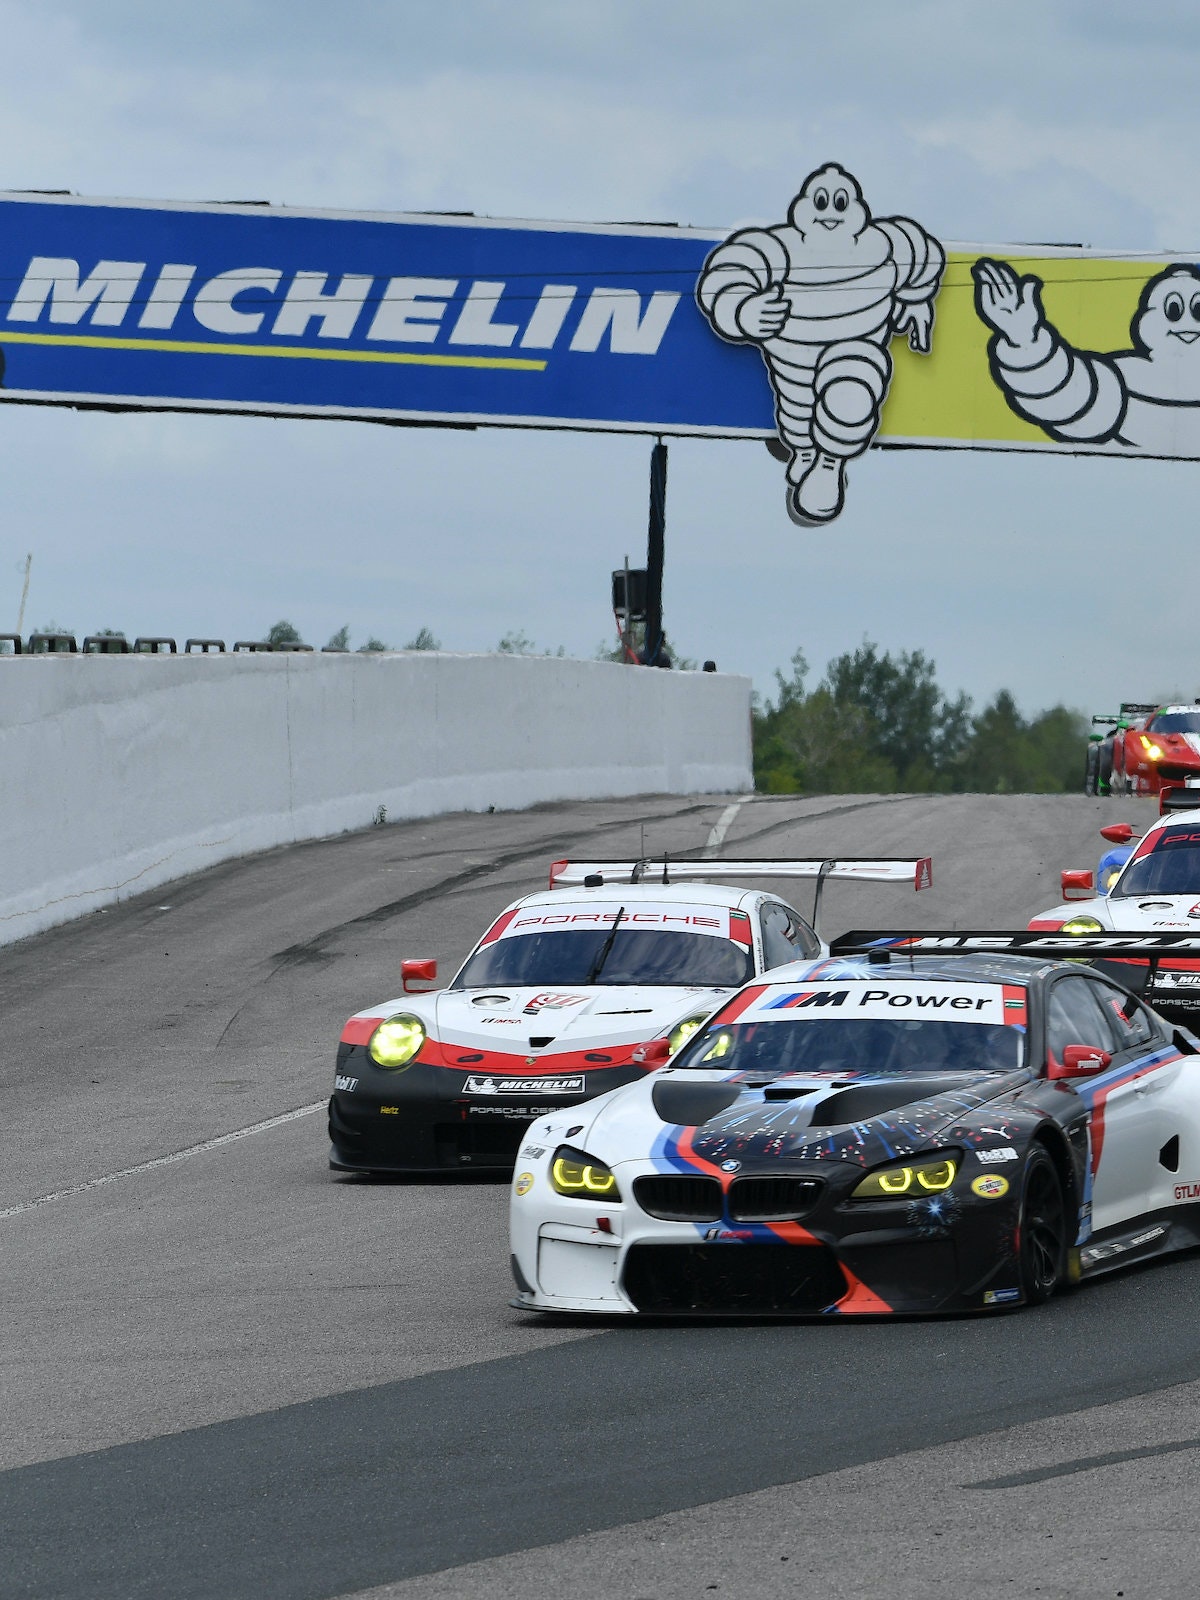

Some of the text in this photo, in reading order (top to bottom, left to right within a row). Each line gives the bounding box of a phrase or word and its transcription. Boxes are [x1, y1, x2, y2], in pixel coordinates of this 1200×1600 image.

[6, 256, 682, 356] MICHELIN
[513, 914, 721, 929] PORSCHE
[859, 990, 993, 1011] Power
[499, 1080, 582, 1089] MICHELIN
[380, 1106, 400, 1115] Hertz
